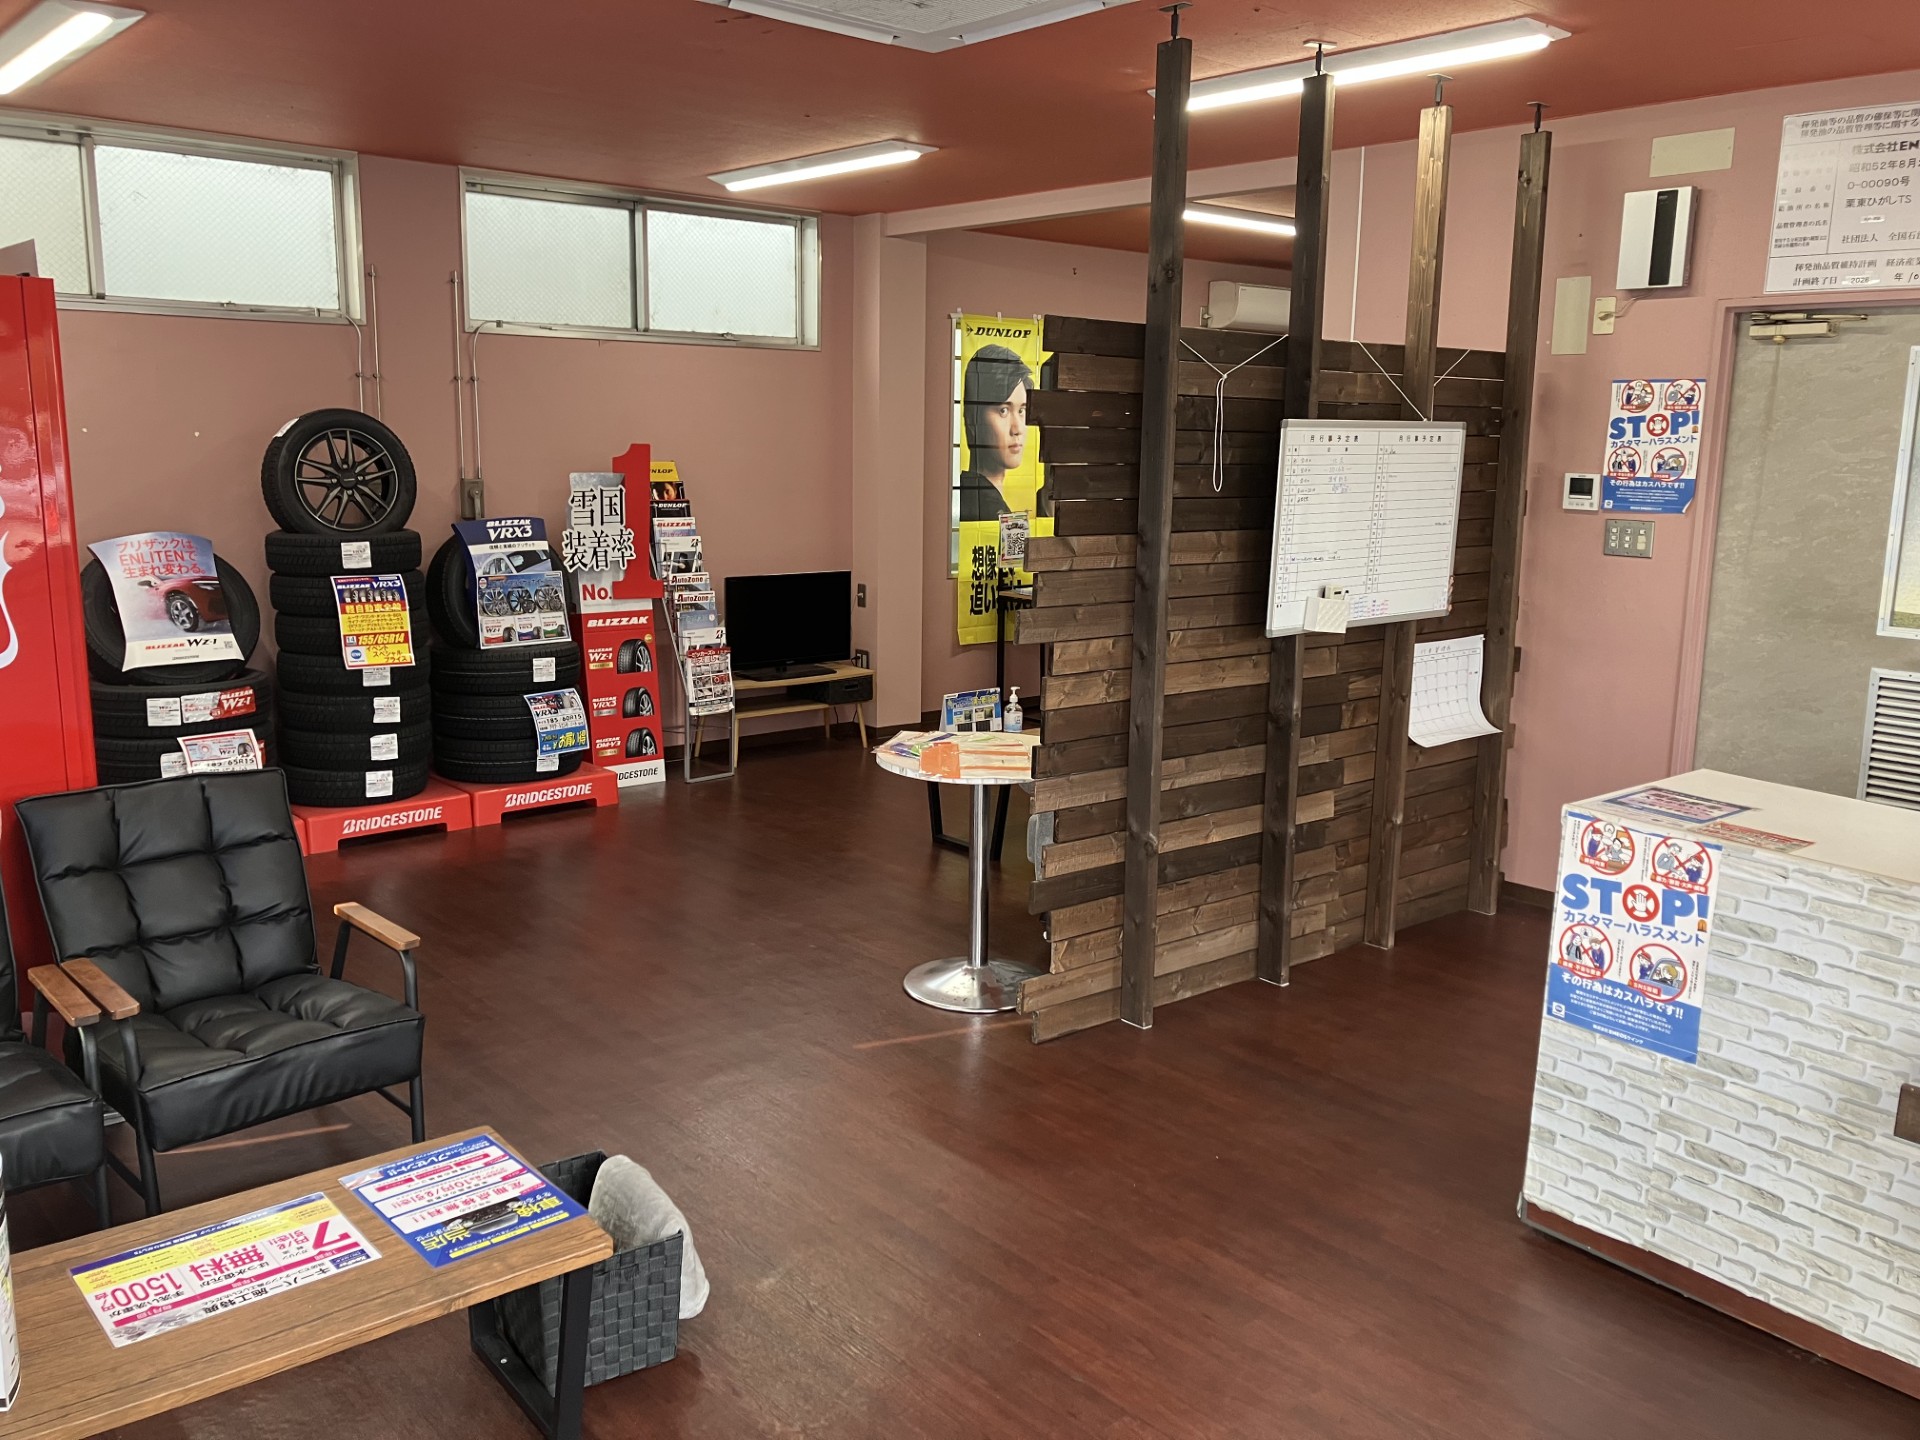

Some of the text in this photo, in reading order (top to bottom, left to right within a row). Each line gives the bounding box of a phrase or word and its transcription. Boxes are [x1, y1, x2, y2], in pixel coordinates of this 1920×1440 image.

[1849, 158, 1920, 173] 昭和52年8月
[974, 326, 1031, 339] DUNLOP
[1608, 410, 1700, 440] STOP!
[1610, 435, 1697, 449] カスタマーハラスメント
[571, 487, 624, 526] 雪国
[485, 519, 531, 528] BLIZZAK
[487, 525, 533, 542] VRX3
[119, 549, 198, 566] ENLITENで
[564, 529, 634, 569] 装着率
[123, 562, 206, 579] 生まれ変わる。
[372, 580, 401, 589] VRX3
[587, 616, 649, 628] BLIZZAK
[358, 632, 405, 646] 155/65R14
[618, 767, 659, 781] DGESTONE
[504, 783, 593, 808] BRIDGESTONE
[342, 806, 443, 834] BRIDGESTONE
[1560, 872, 1710, 933] STOP!
[1563, 909, 1705, 948] カスタマーハラスメント
[189, 1244, 265, 1282] 無料
[200, 1265, 332, 1315] キーパー施工特典
